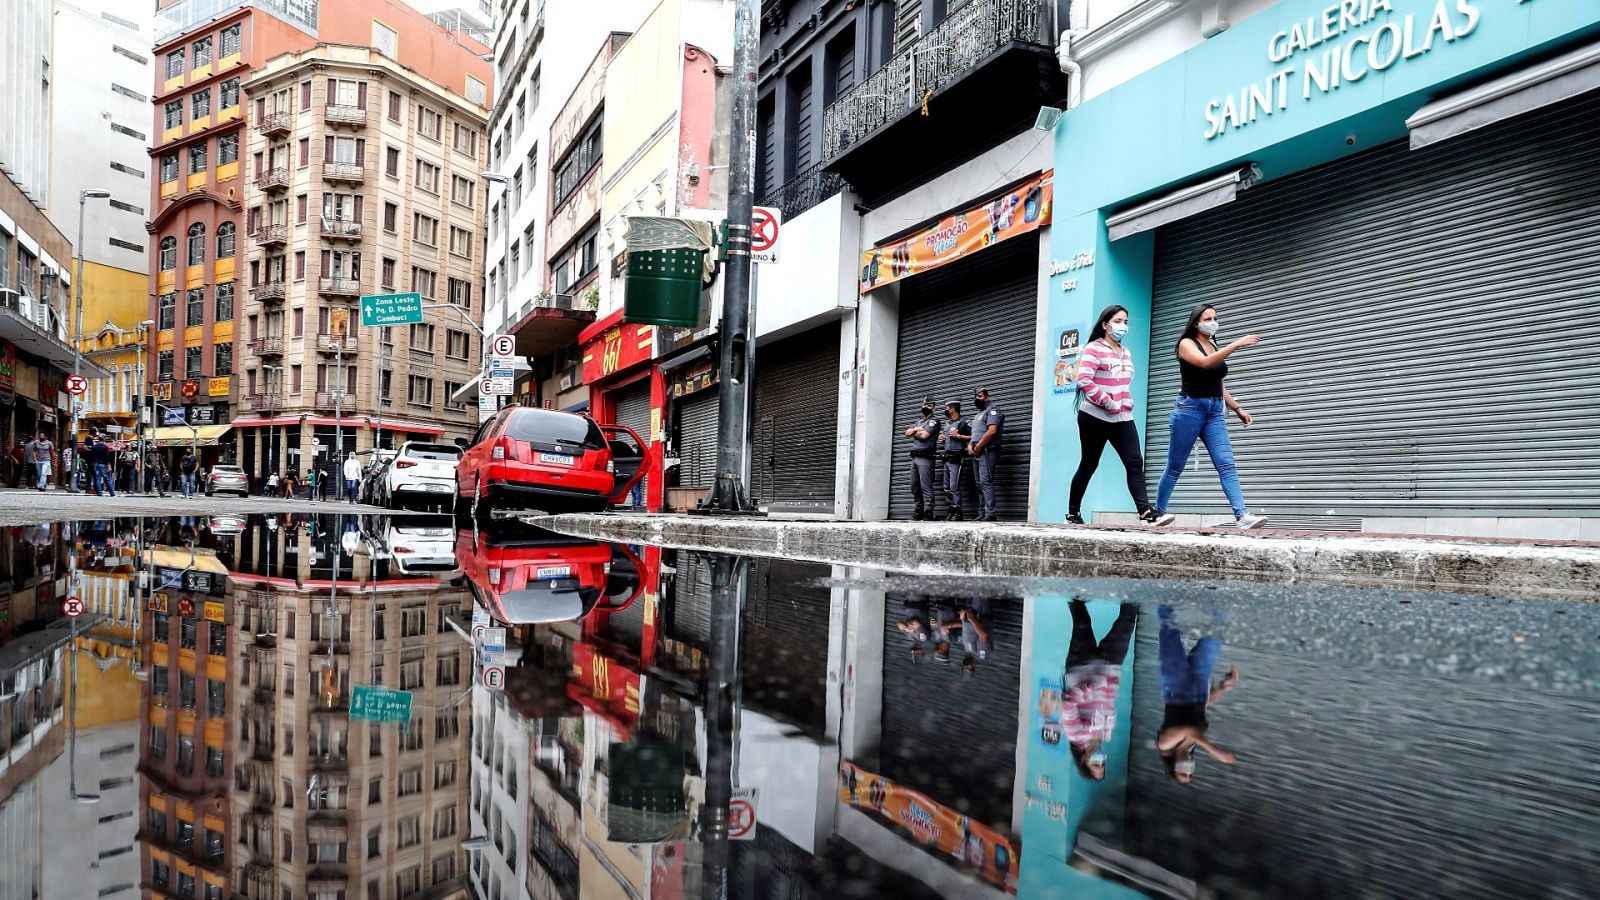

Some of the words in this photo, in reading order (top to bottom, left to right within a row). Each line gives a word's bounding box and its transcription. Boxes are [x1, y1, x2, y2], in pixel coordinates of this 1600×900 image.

[1267, 0, 1393, 62] GALERIA
[1203, 66, 1295, 140] SAINT
[1303, 0, 1480, 101] NICOLAS
[375, 298, 393, 306] Zona
[394, 296, 415, 304] Leste
[376, 314, 407, 323] Cambuci
[500, 340, 508, 352] E
[1062, 332, 1078, 348] Café
[484, 382, 491, 392] E
